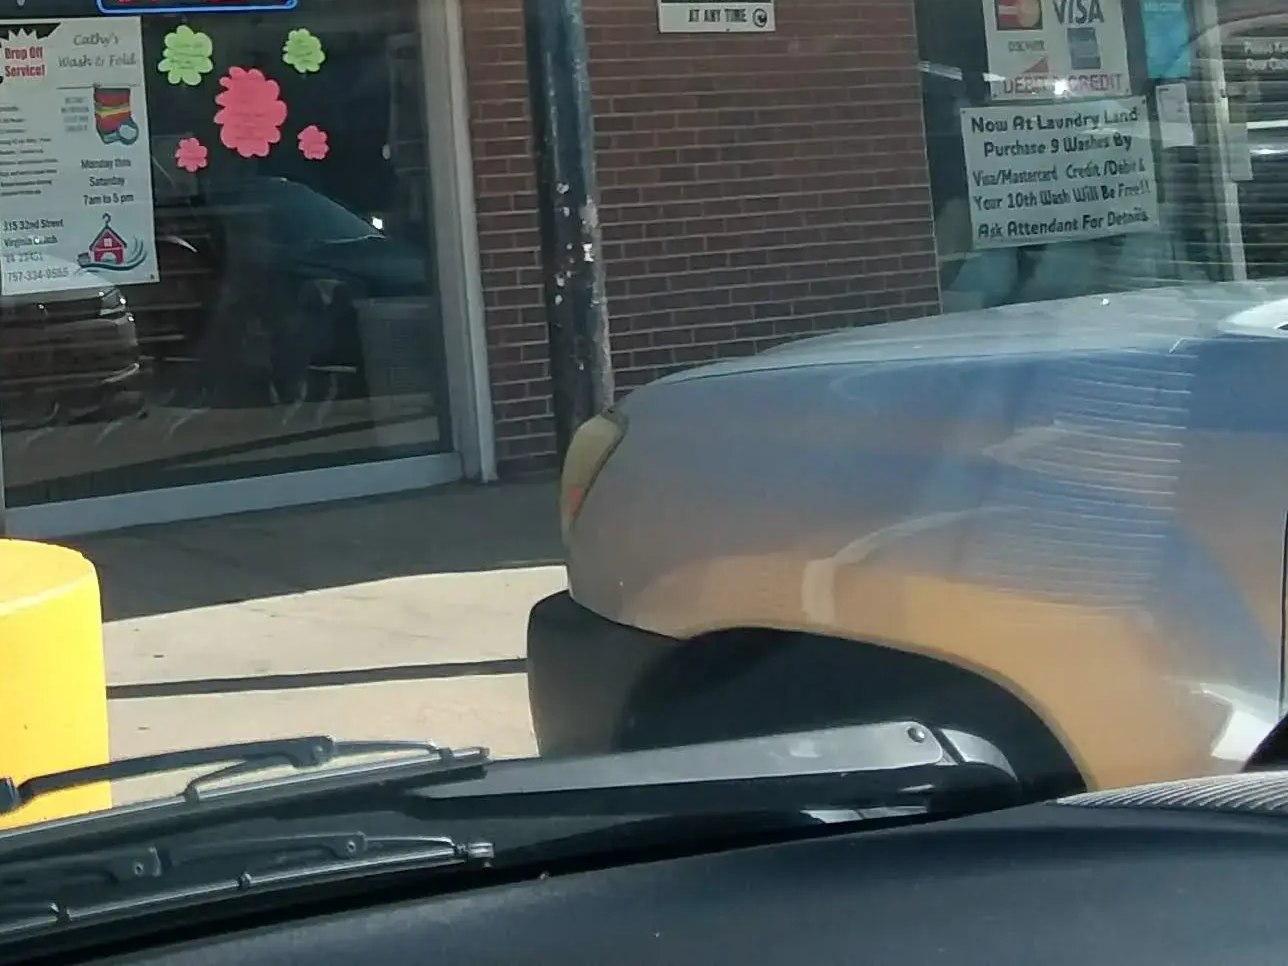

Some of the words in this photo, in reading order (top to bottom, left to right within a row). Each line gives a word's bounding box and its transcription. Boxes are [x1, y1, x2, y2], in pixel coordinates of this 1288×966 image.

[703, 8, 721, 23] ANY
[724, 8, 748, 23] TIME
[73, 31, 120, 48] Cathy's
[4, 47, 28, 61] Drop
[29, 46, 43, 59] Off
[57, 55, 93, 69] Wash
[108, 52, 138, 67] Fold
[4, 64, 46, 78] Service!
[1067, 73, 1124, 92] CREDIT
[970, 116, 1009, 134] Now
[1013, 115, 1033, 132] At
[1037, 112, 1100, 131] Laundry
[1103, 105, 1139, 124] Land
[983, 141, 1047, 158] Purchase
[1050, 138, 1060, 153] 9
[1063, 135, 1110, 153] Washes
[1112, 132, 1133, 152] By
[80, 158, 113, 171] Monday
[1065, 160, 1101, 180] Credit
[88, 175, 126, 188] Saturday
[83, 193, 102, 206] 7am
[103, 194, 112, 205] to
[120, 193, 134, 205] pm
[972, 195, 1003, 211] Your
[1007, 191, 1038, 210] 10th
[1040, 188, 1072, 206] Wash
[1073, 185, 1100, 203] Will
[1100, 184, 1116, 201] Be
[3, 219, 18, 232] 315
[19, 218, 40, 231] 32nd
[40, 217, 64, 229] Street
[978, 222, 1005, 239] Ask
[1008, 216, 1079, 238] Attendant
[1081, 213, 1105, 230] For
[1107, 206, 1149, 228] Details
[3, 236, 33, 249] Virginia
